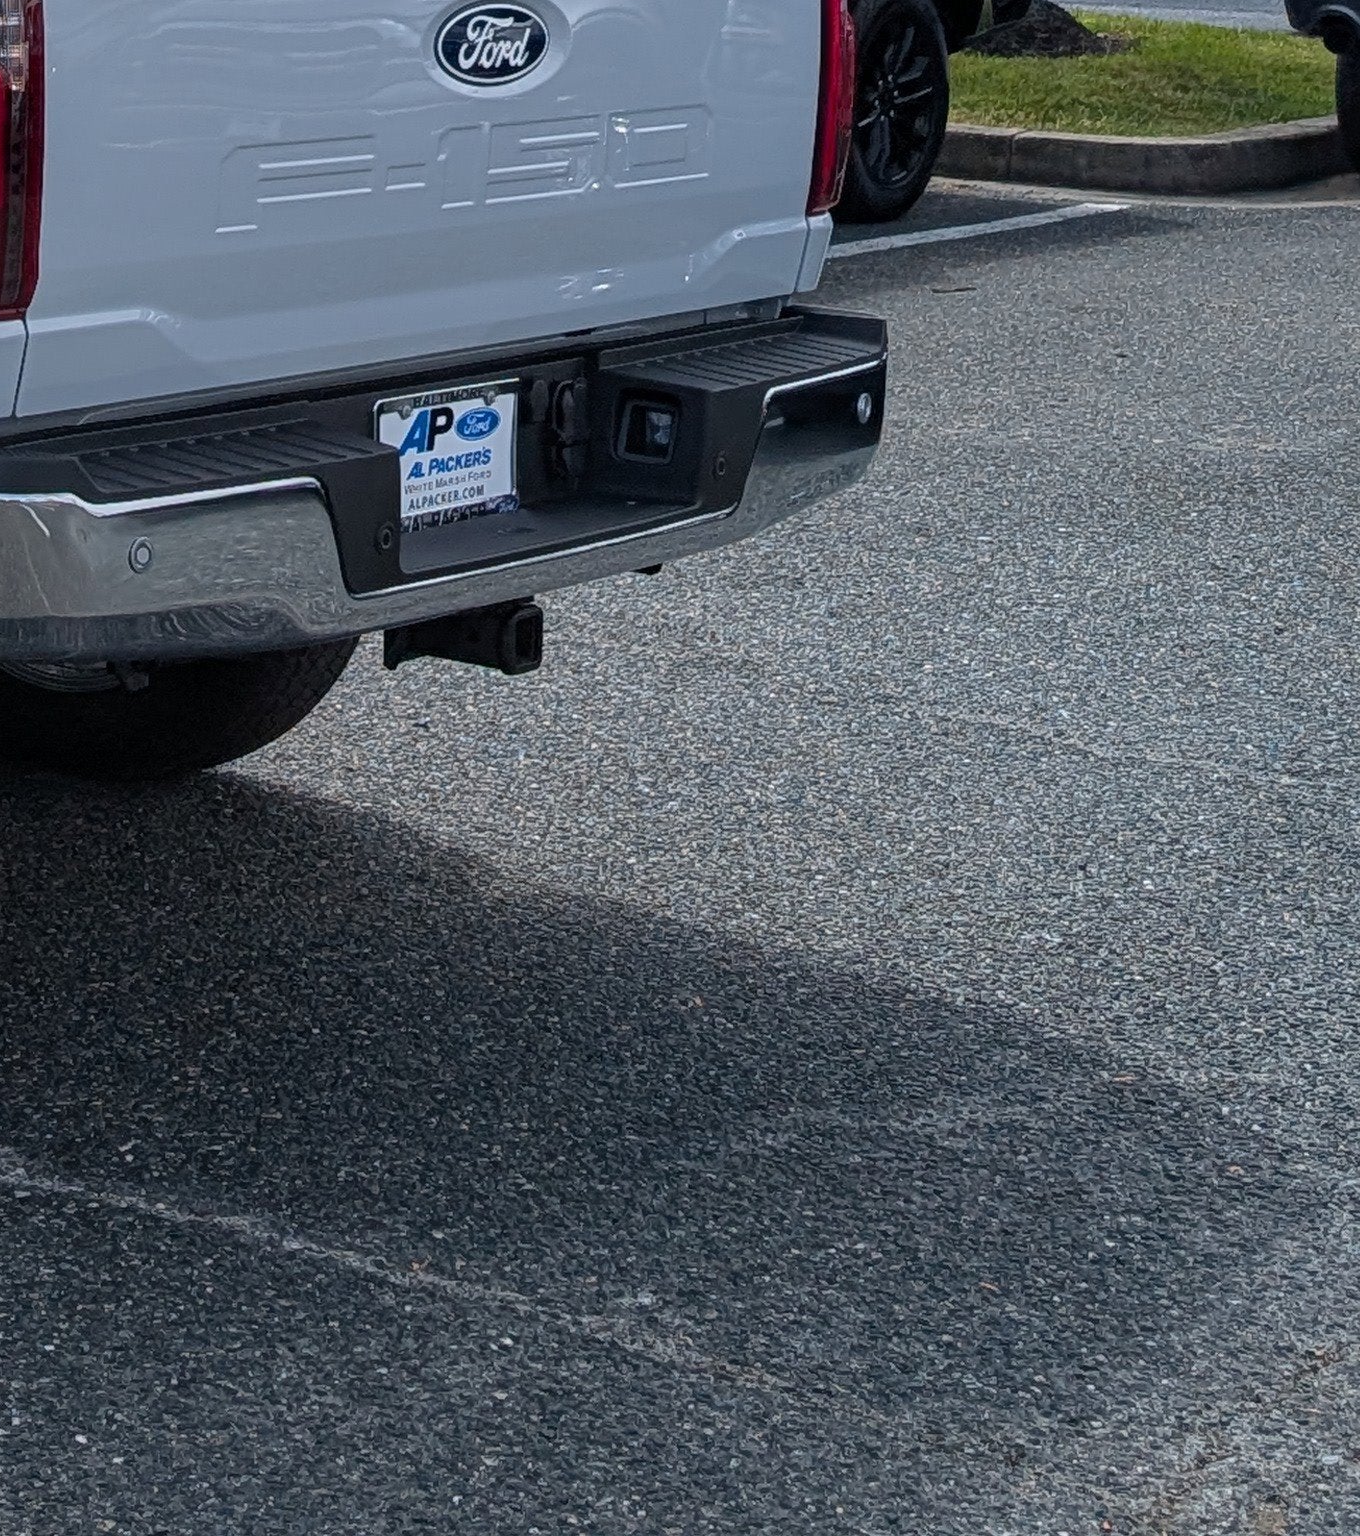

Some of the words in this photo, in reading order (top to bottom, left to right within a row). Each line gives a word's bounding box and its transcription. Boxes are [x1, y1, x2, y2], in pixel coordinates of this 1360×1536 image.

[459, 14, 530, 68] Ford
[214, 103, 711, 233] F-150
[399, 407, 454, 457] AP
[406, 461, 425, 481] AL
[428, 446, 492, 476] PACKER'S
[408, 484, 485, 511] ALPACKER.COM
